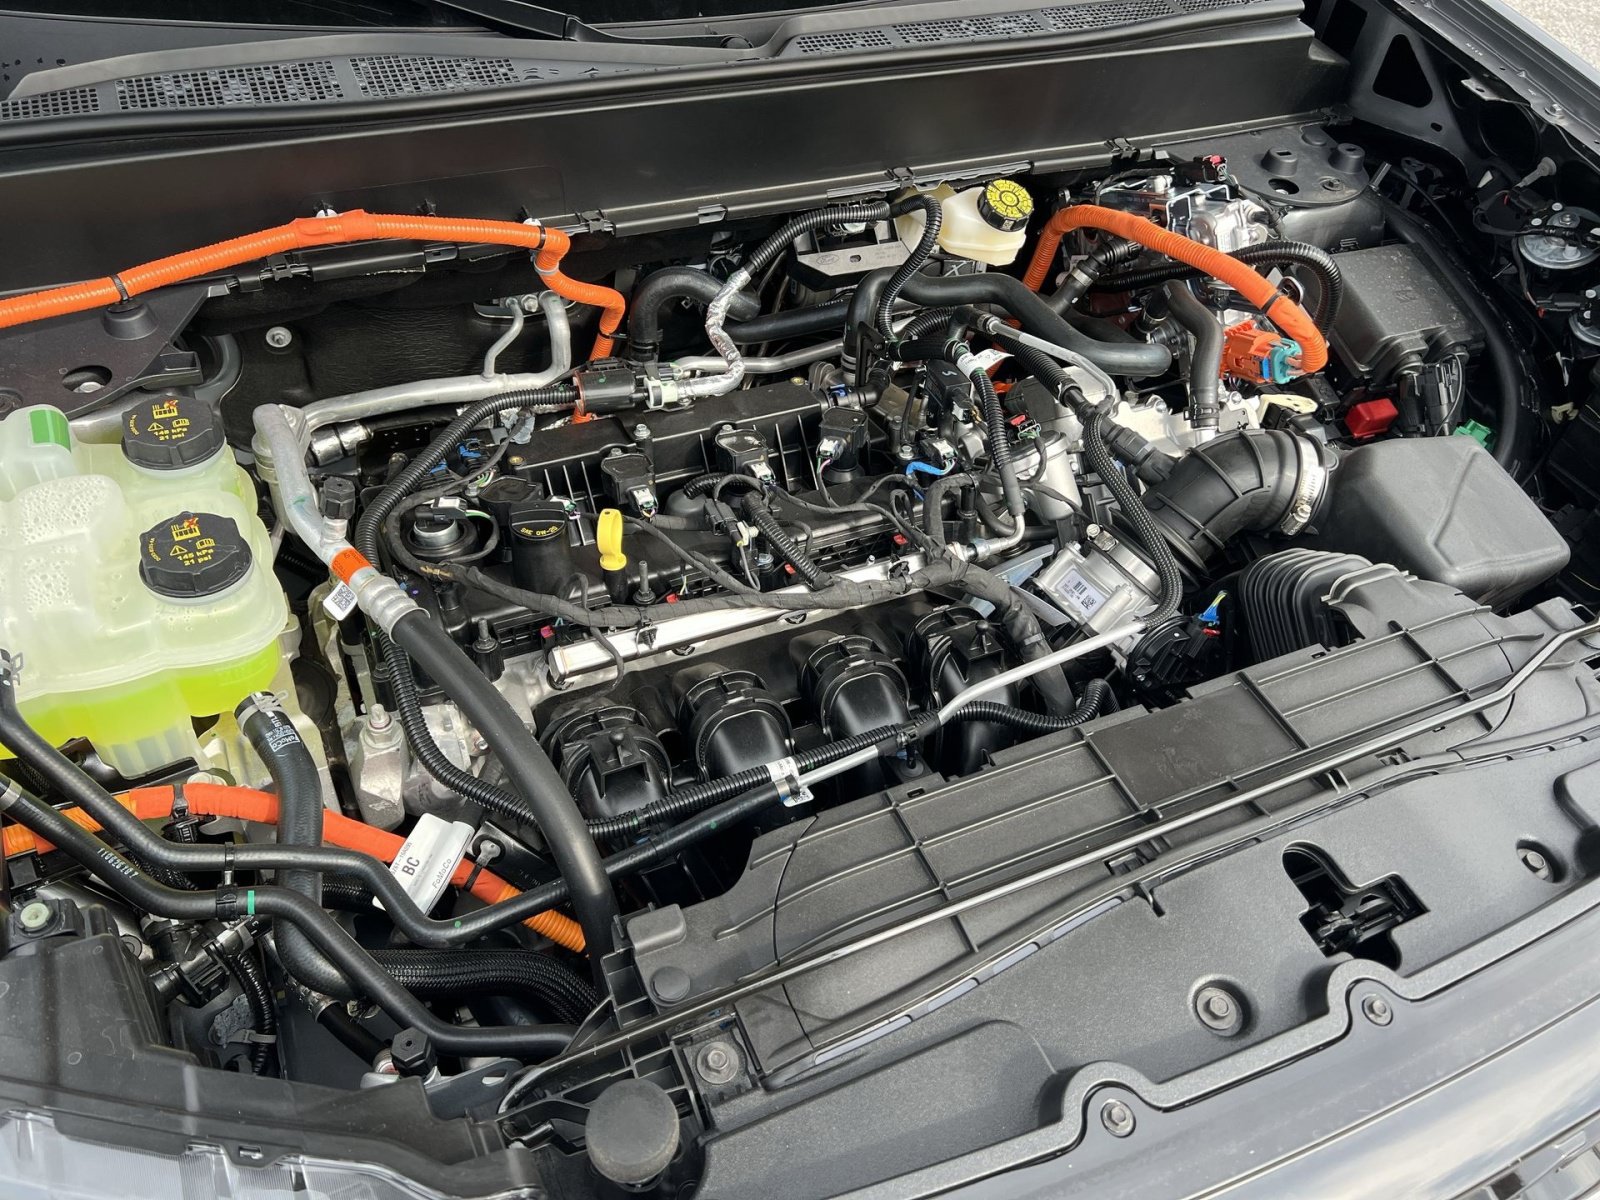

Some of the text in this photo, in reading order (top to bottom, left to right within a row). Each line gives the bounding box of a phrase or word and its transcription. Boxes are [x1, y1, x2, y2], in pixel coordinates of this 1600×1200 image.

[520, 527, 533, 536] SAE
[177, 552, 195, 561] 145
[197, 554, 213, 564] psi
[401, 856, 420, 876] BC
[431, 858, 452, 889] FoMoCo
